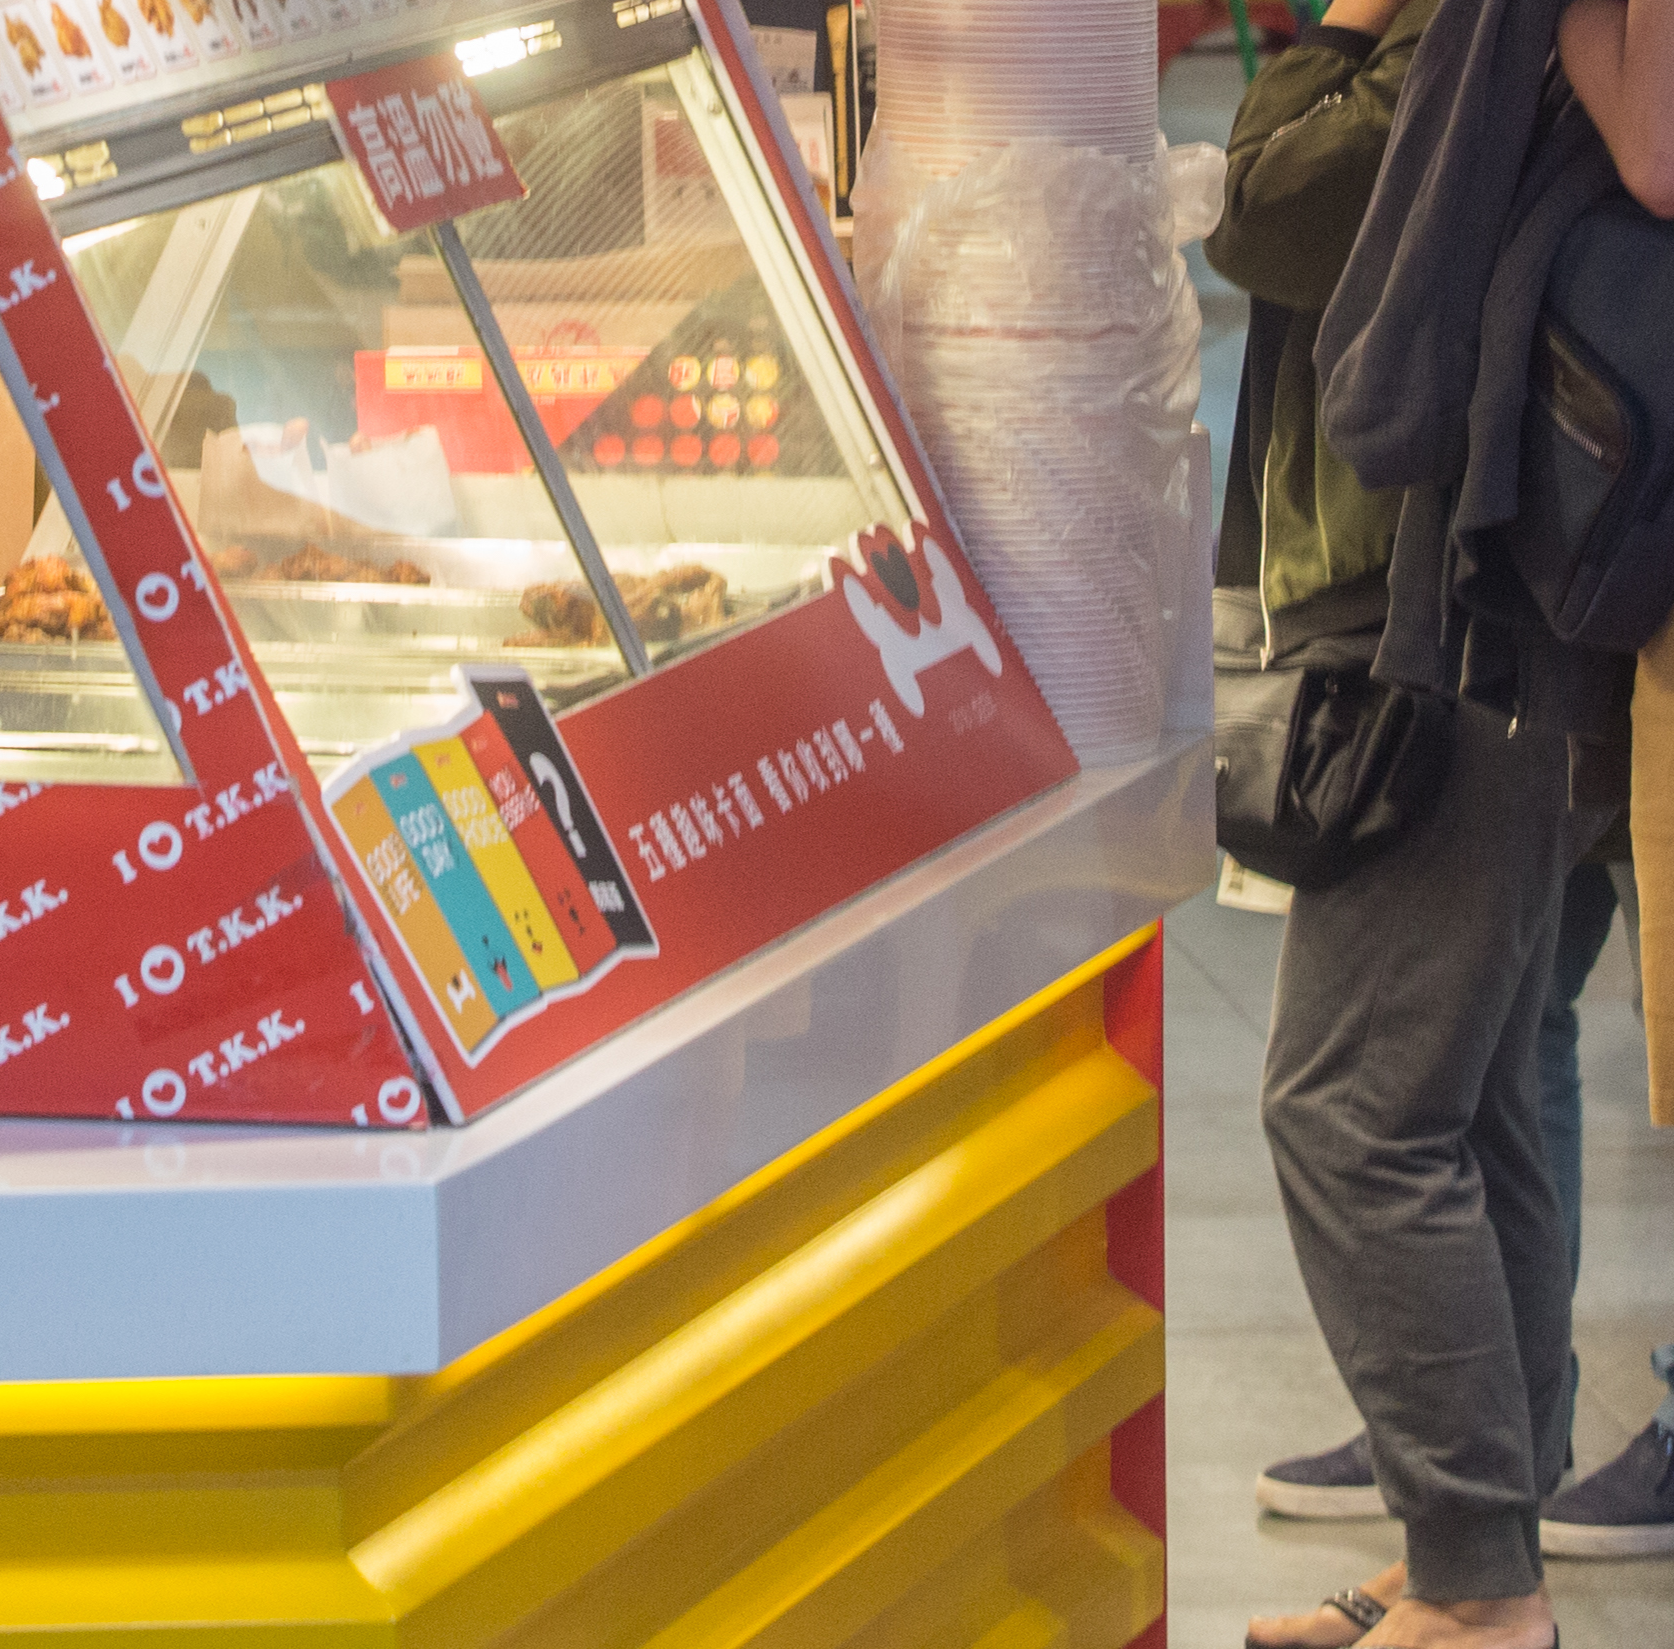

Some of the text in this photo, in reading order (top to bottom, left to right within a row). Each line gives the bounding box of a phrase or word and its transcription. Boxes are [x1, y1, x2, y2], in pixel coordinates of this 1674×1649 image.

[112, 850, 137, 884] I
[114, 885, 303, 1008] I T.K.K.
[188, 1009, 306, 1086] T.K.K.
